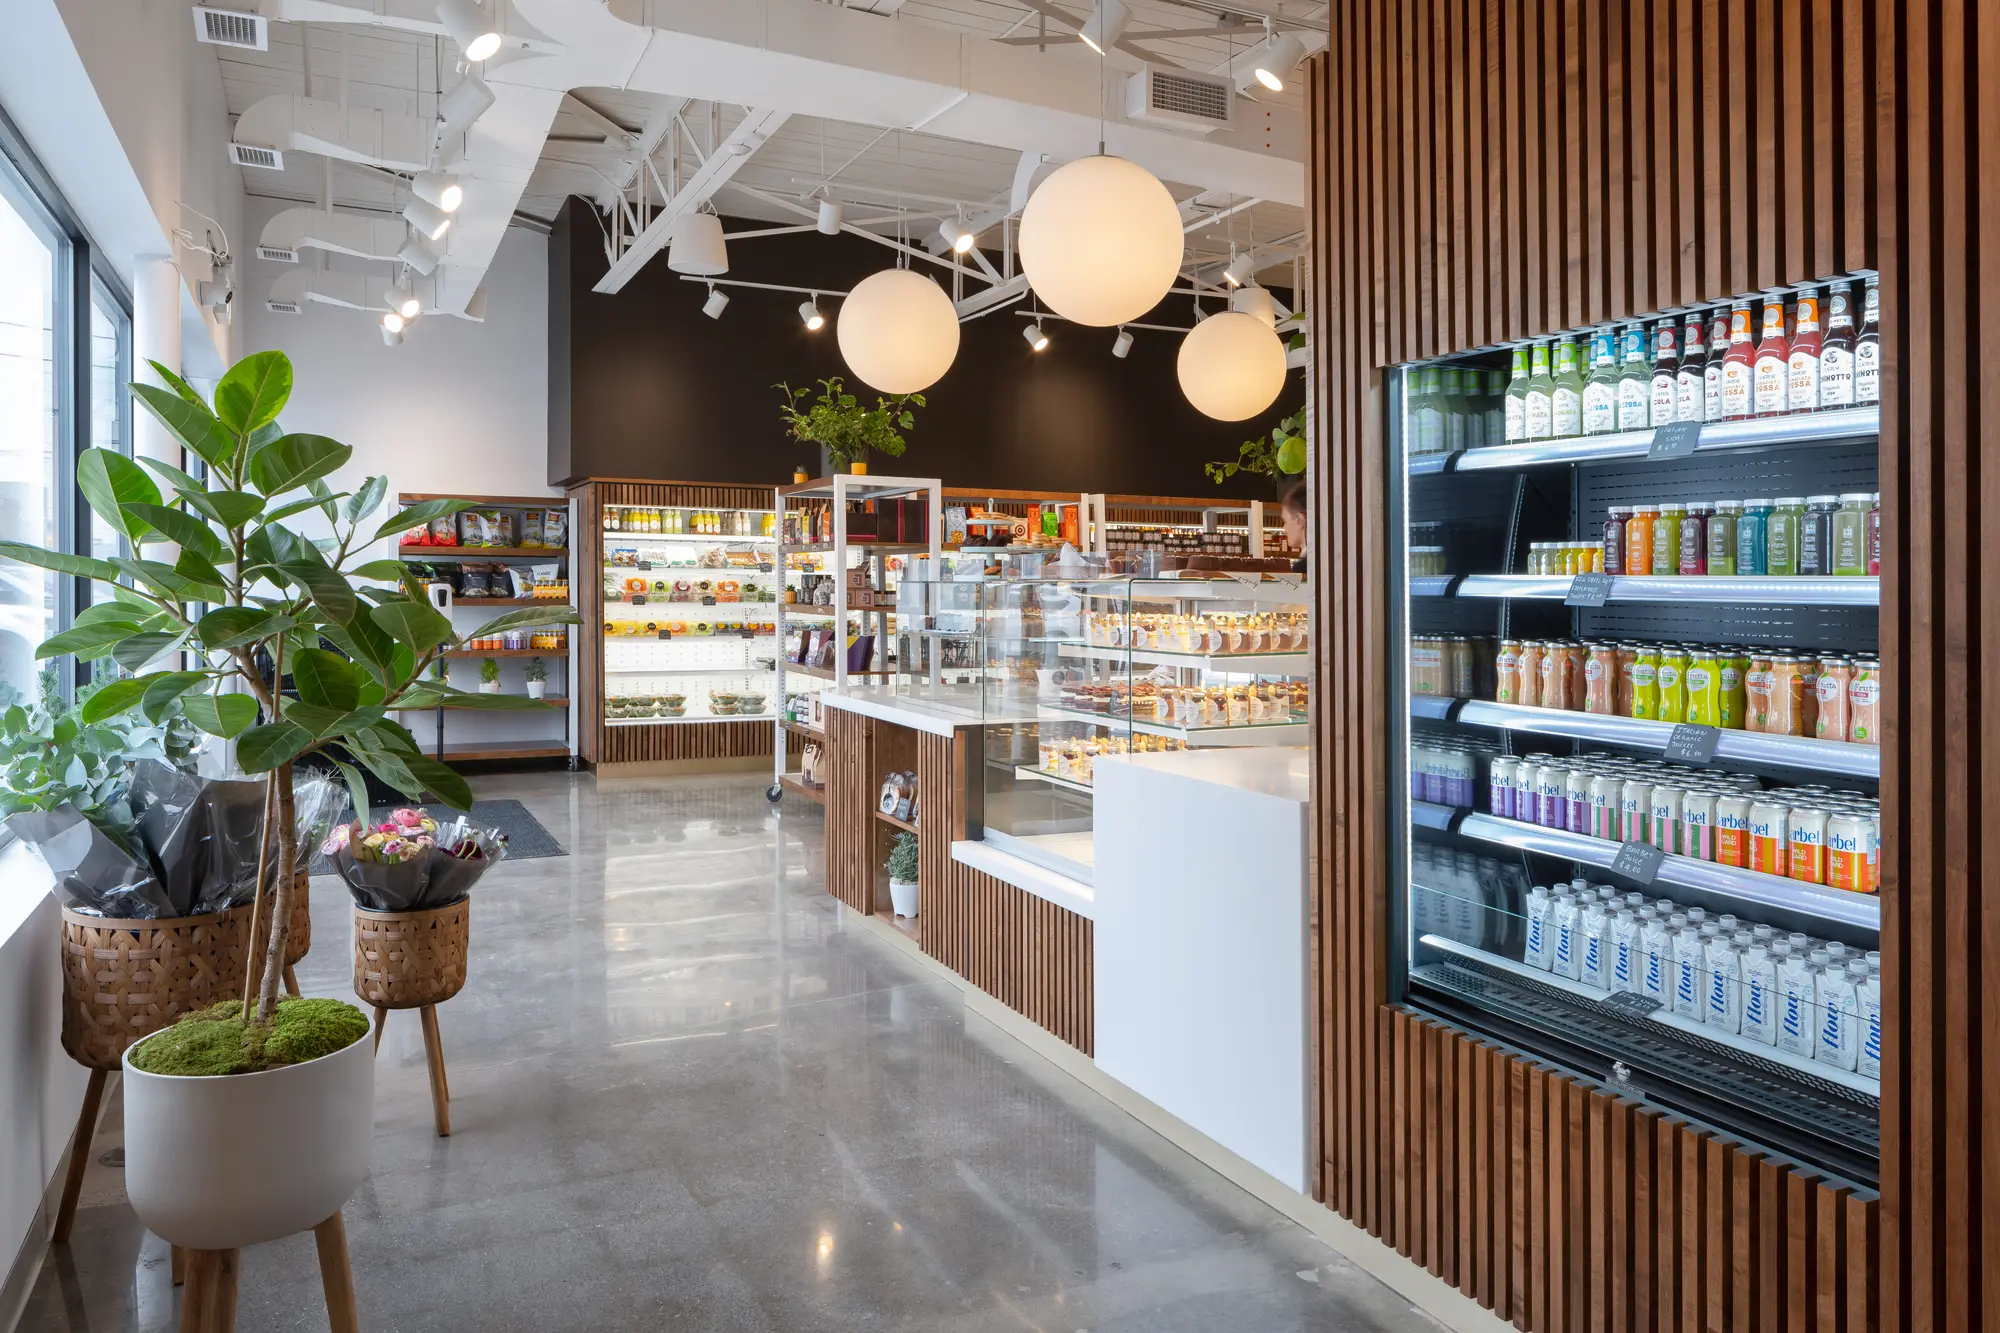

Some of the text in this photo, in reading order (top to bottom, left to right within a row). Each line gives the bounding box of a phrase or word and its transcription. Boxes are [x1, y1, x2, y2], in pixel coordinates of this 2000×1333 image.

[1529, 916, 1540, 953] flow
[1557, 924, 1568, 962] flow
[1615, 942, 1628, 982] flow
[1646, 951, 1660, 992] flow
[1678, 960, 1692, 1003] flow
[1710, 970, 1725, 1013] flow
[1746, 980, 1762, 1025] flow
[1783, 991, 1798, 1037] flow
[1822, 1002, 1839, 1049] flow
[1864, 1014, 1880, 1061] flow
